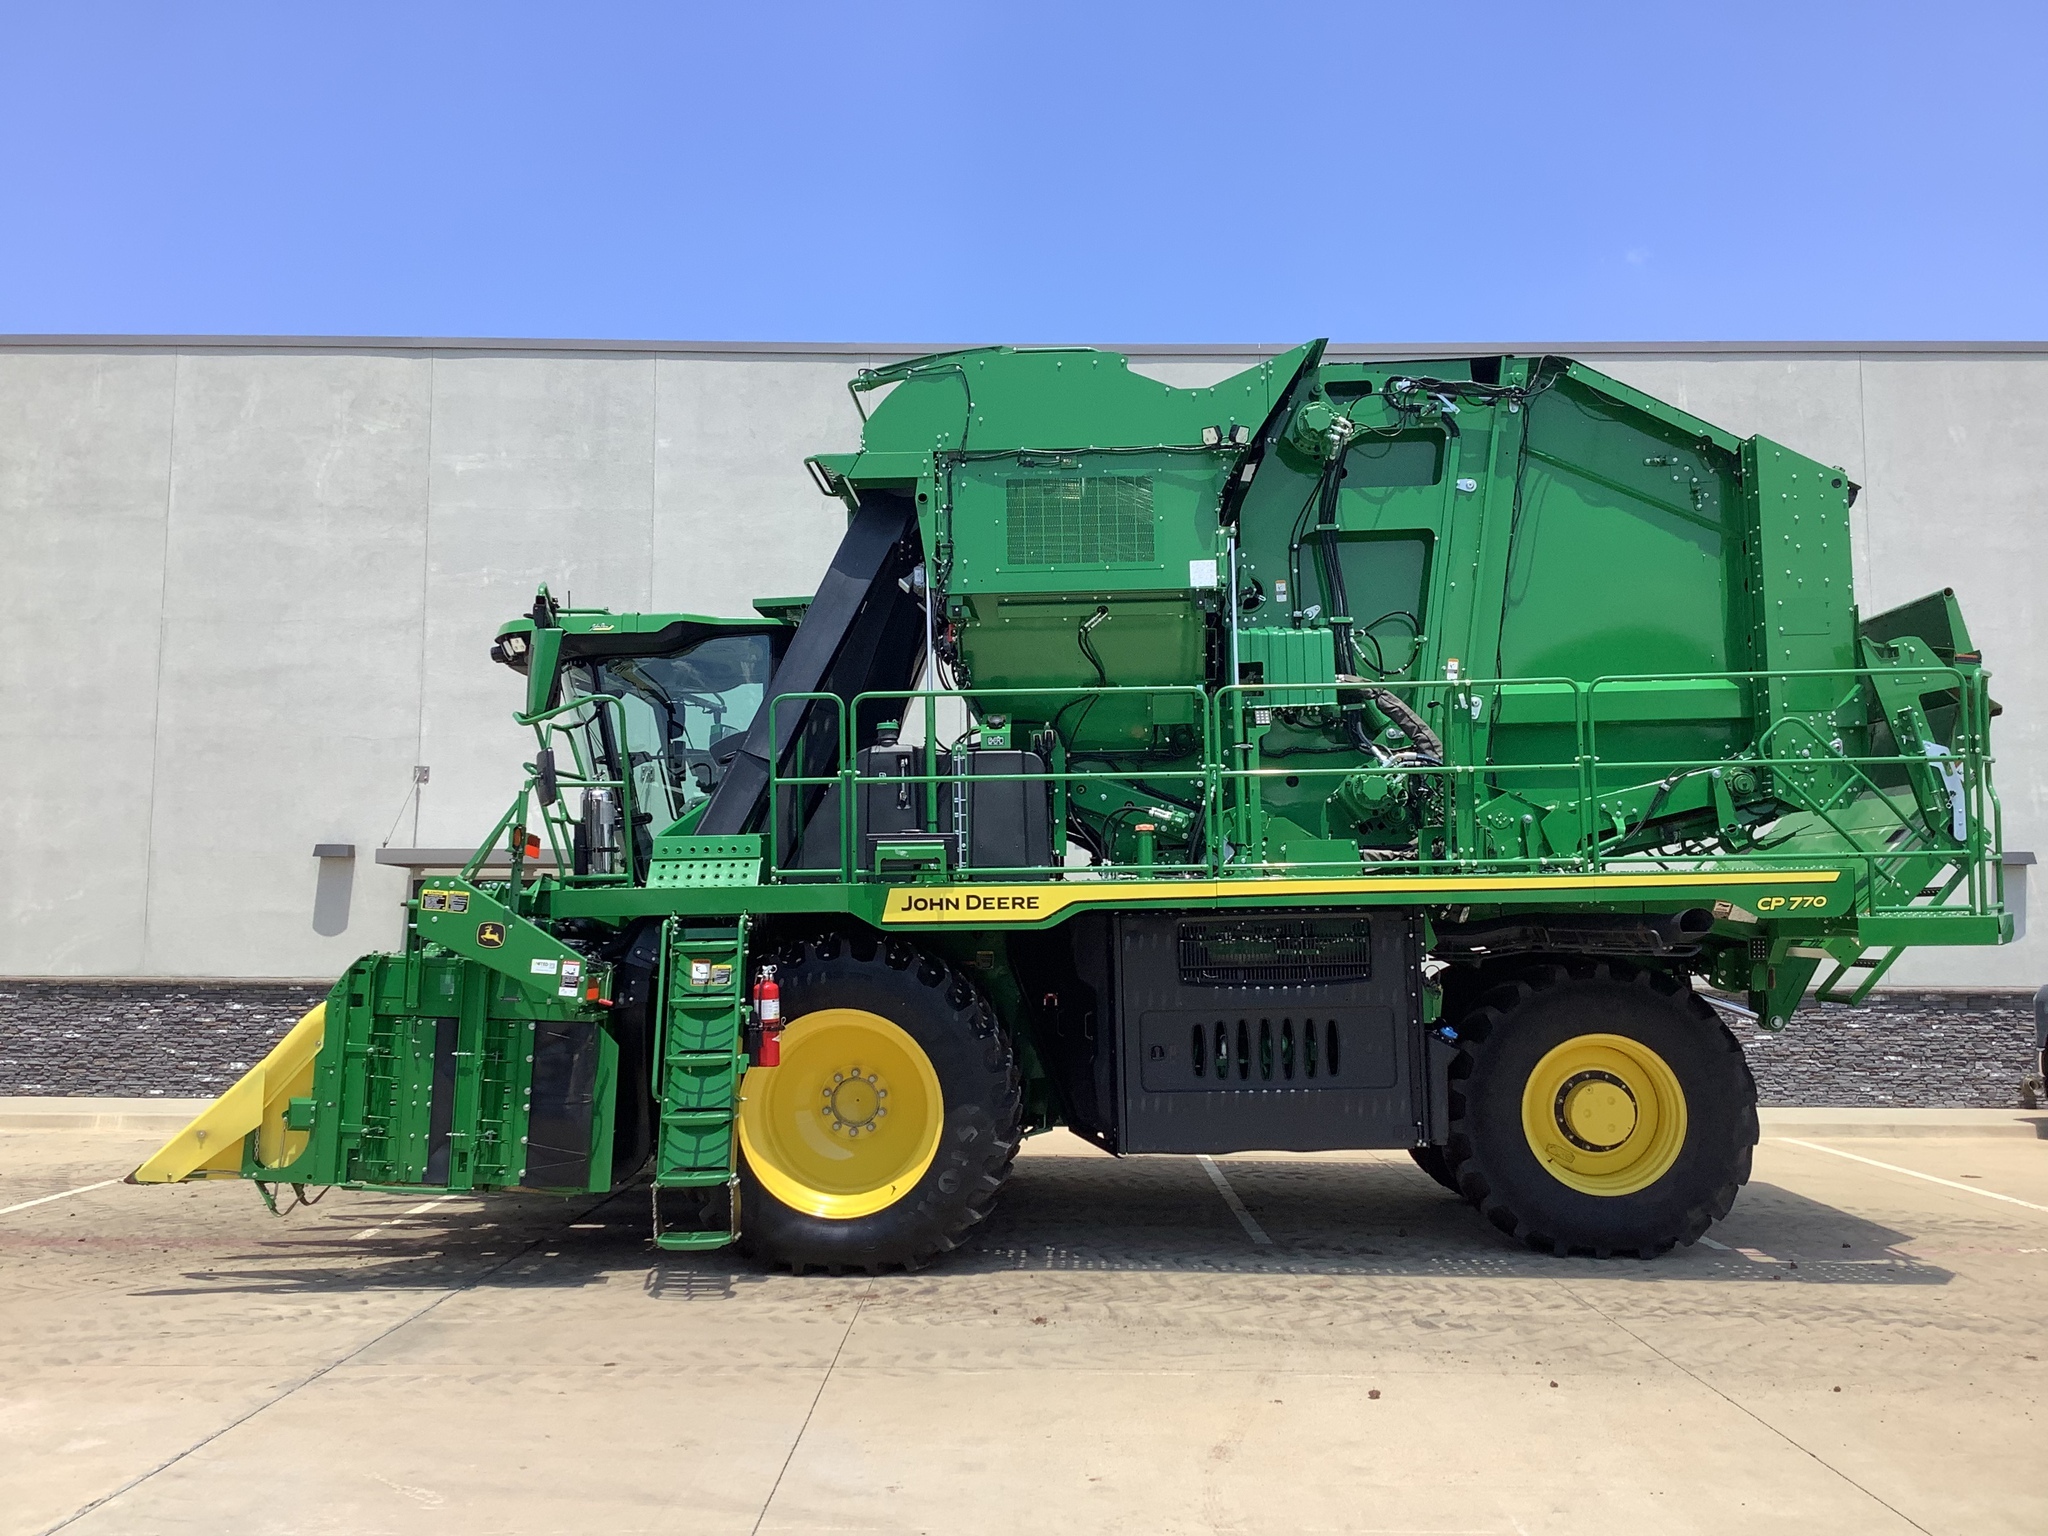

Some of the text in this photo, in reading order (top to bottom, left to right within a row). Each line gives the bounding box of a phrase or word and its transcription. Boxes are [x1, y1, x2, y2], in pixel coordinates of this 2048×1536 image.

[901, 894, 1040, 911] JOHN DEERE
[1756, 895, 1828, 911] CP 770
